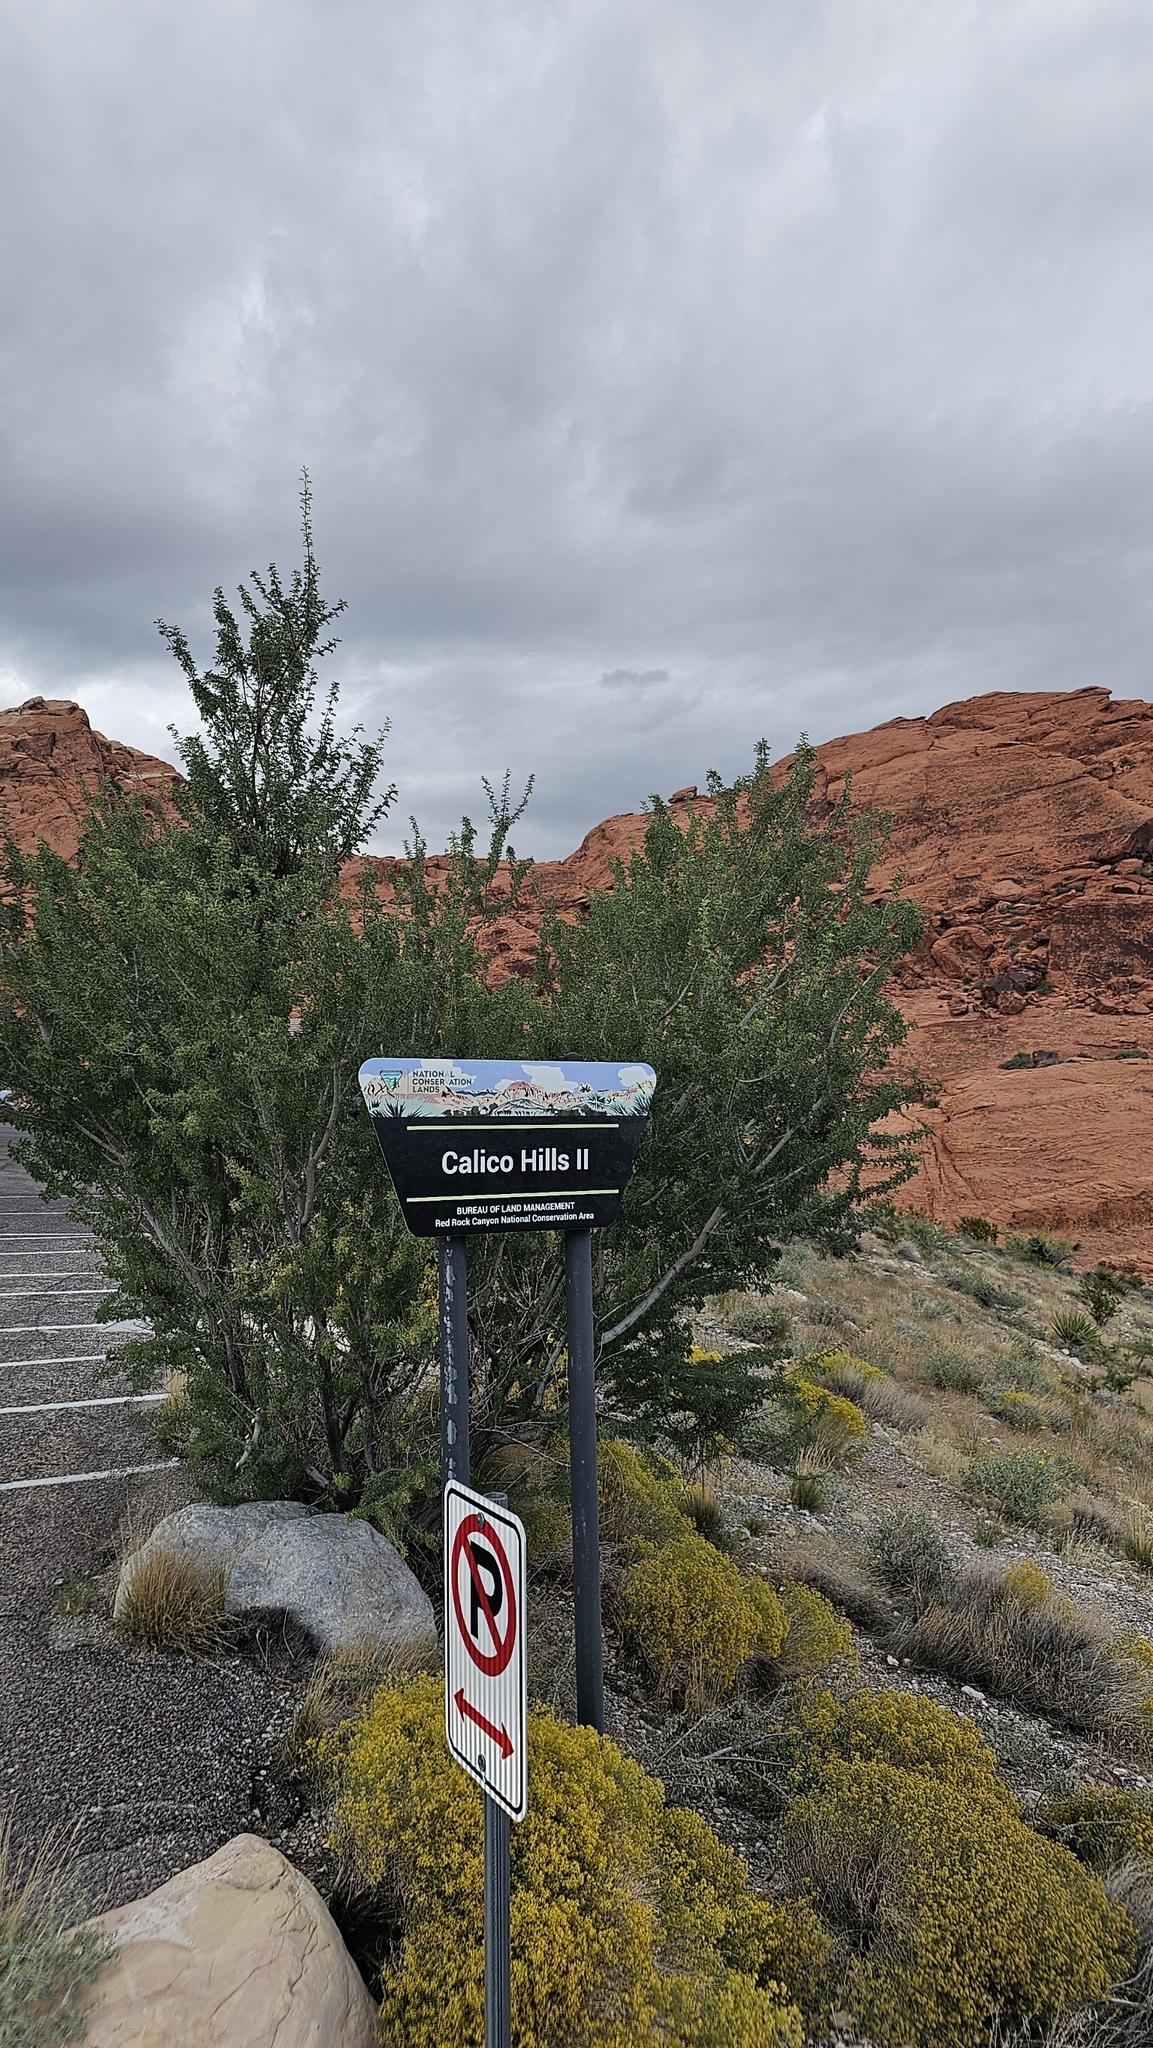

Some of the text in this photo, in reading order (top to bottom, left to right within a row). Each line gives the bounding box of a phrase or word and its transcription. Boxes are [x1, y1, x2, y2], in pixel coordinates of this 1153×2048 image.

[412, 1078, 472, 1086] CONSERATION
[441, 1147, 589, 1174] Calico Hills II
[456, 1202, 576, 1215] BUREAU OF LAND MANAGEMENT
[435, 1212, 595, 1228] Red Rock Canyon National Conservation Area
[470, 1540, 503, 1640] P
